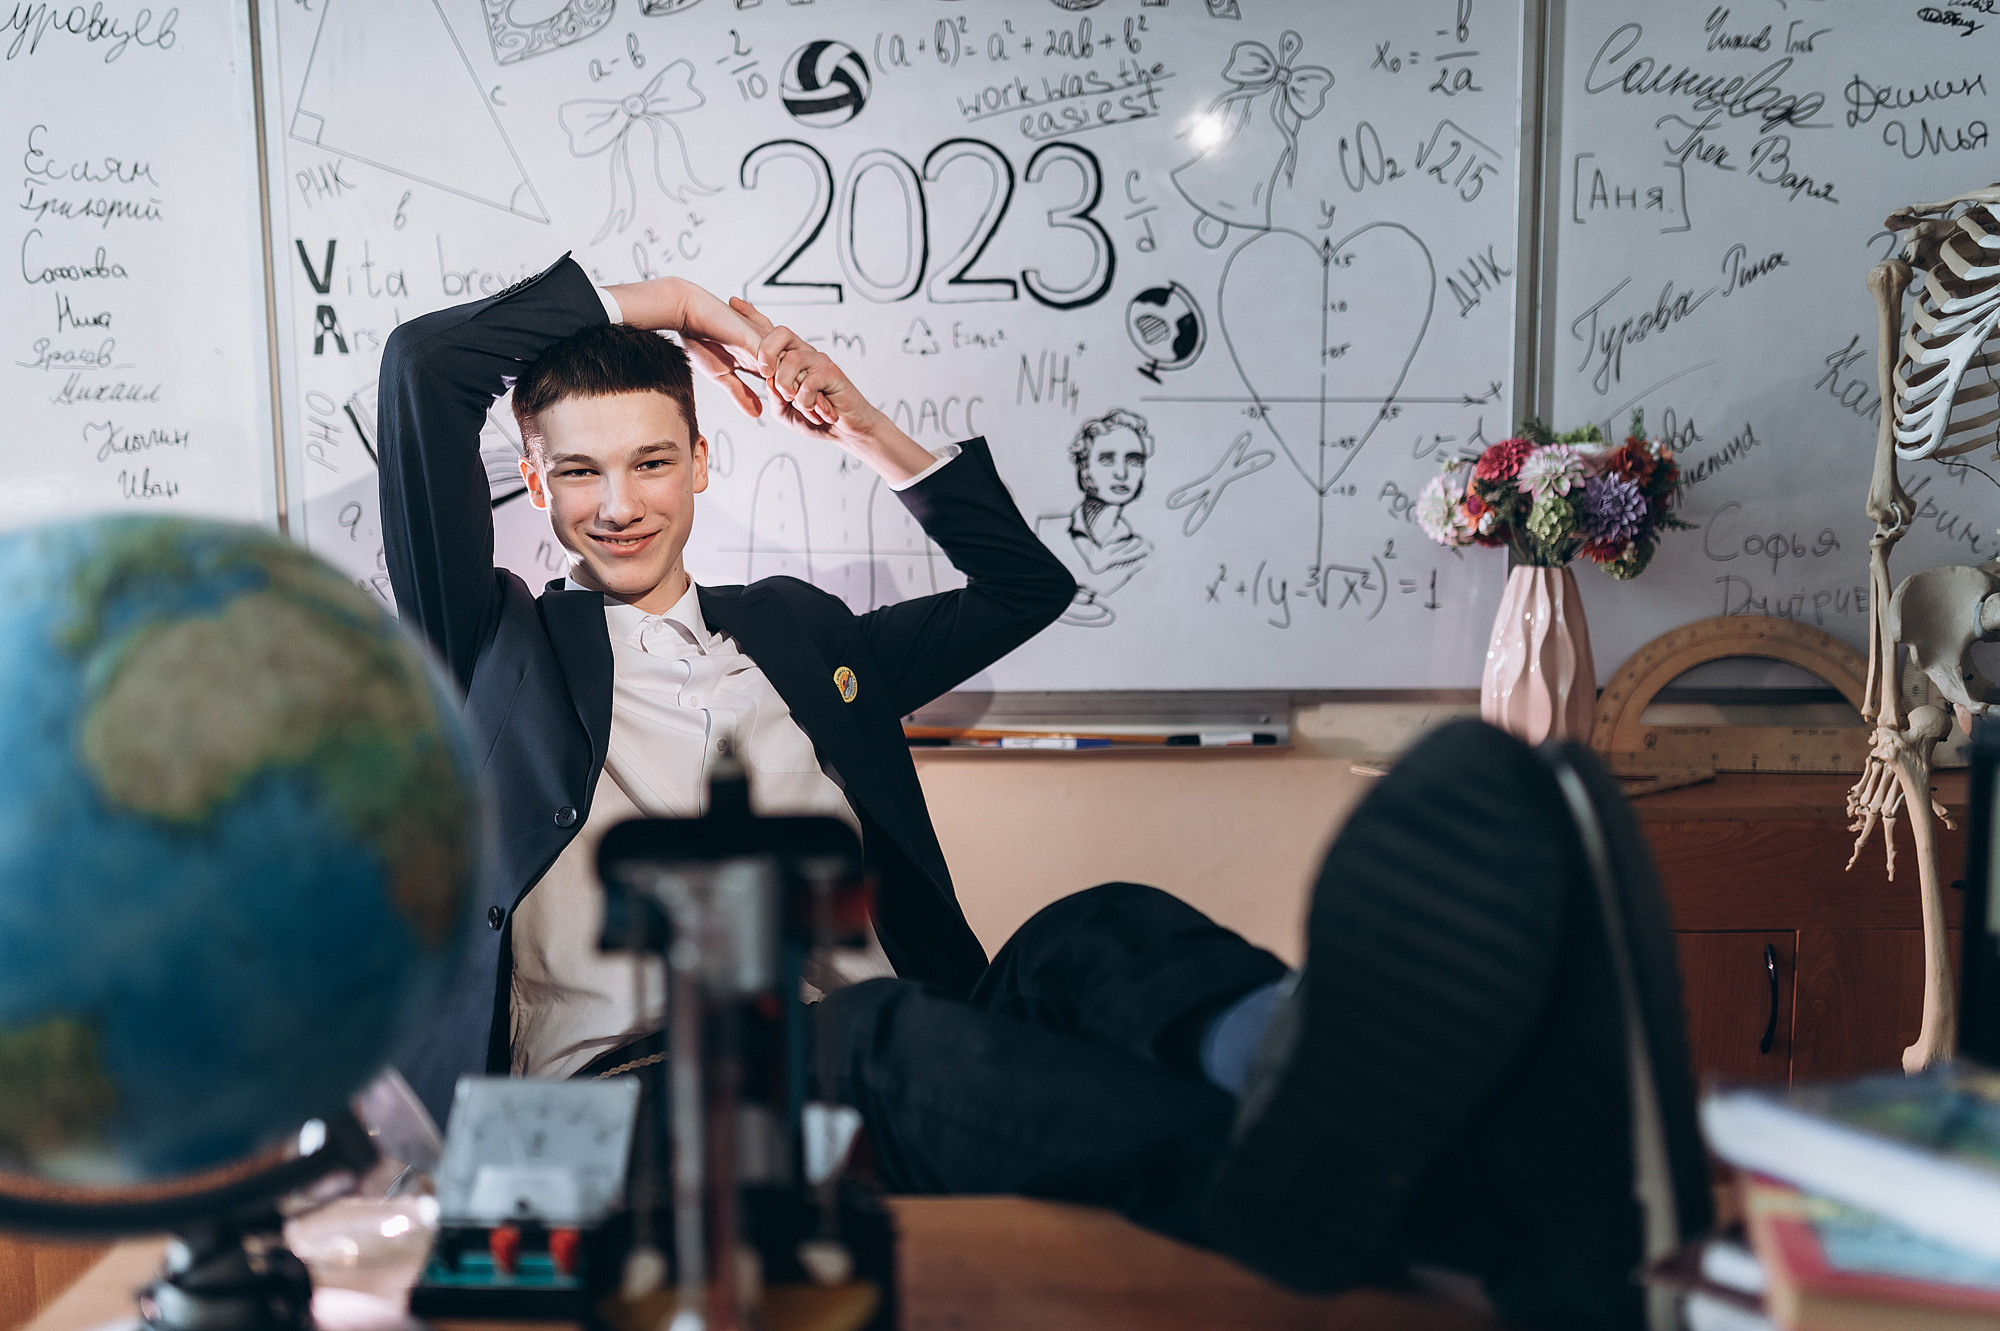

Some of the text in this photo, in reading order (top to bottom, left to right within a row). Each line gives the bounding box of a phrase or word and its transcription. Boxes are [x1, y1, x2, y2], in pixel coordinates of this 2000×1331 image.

[0, 2, 179, 64] уровцев
[956, 58, 1166, 118] work was the
[1020, 84, 1164, 140] easiest
[1883, 118, 1989, 160] Илья
[739, 138, 1117, 310] 2023
[295, 238, 409, 299] Vita
[313, 304, 381, 356] Ars
[876, 393, 985, 439] ЛАСС
[118, 468, 180, 500] Иван
[1703, 500, 1841, 576] Софья
